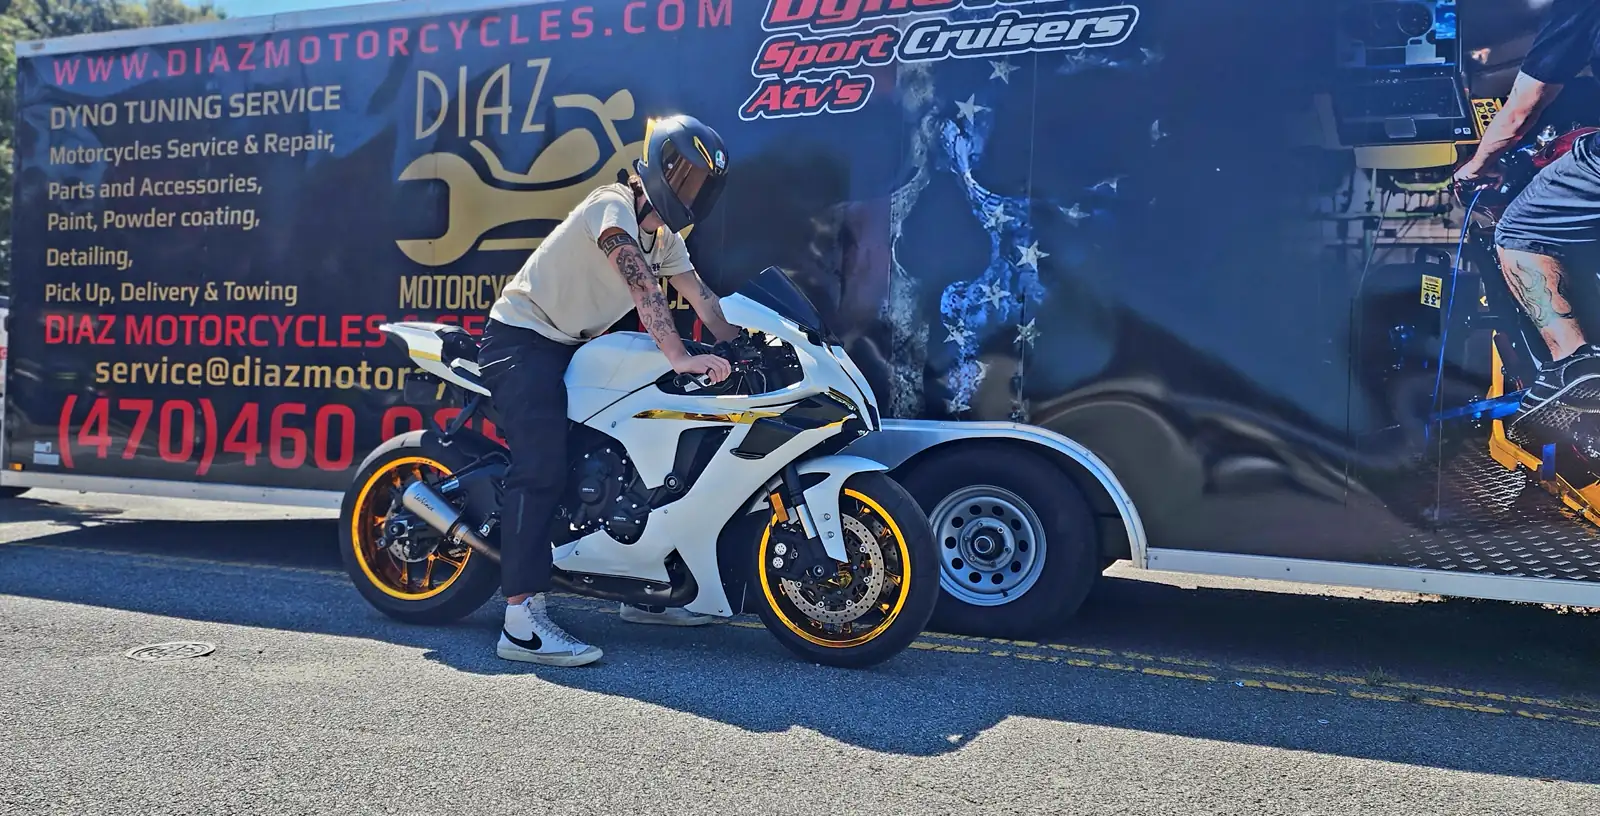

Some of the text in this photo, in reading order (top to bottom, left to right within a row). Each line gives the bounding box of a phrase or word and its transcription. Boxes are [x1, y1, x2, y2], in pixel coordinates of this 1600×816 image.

[54, 0, 732, 85] WWW.DIAZMOTORCYCLES.COM
[759, 13, 1130, 72] Sport Cruisers
[51, 85, 341, 130] DYNO TUNING SERVICE
[415, 57, 552, 140] DIAZ
[747, 79, 866, 113] Atv's
[50, 130, 336, 166] Motorcycles Service & Repair,
[48, 175, 263, 200] Parts and Accessories,
[48, 206, 260, 232] Paint, Powder coating,
[46, 247, 134, 271] Detailing,
[45, 280, 298, 307] Pick Up, Delivery & Towing
[399, 274, 513, 309] MOTORCY
[45, 314, 117, 344] DIAZ
[125, 314, 388, 348] MOTORCYCLES
